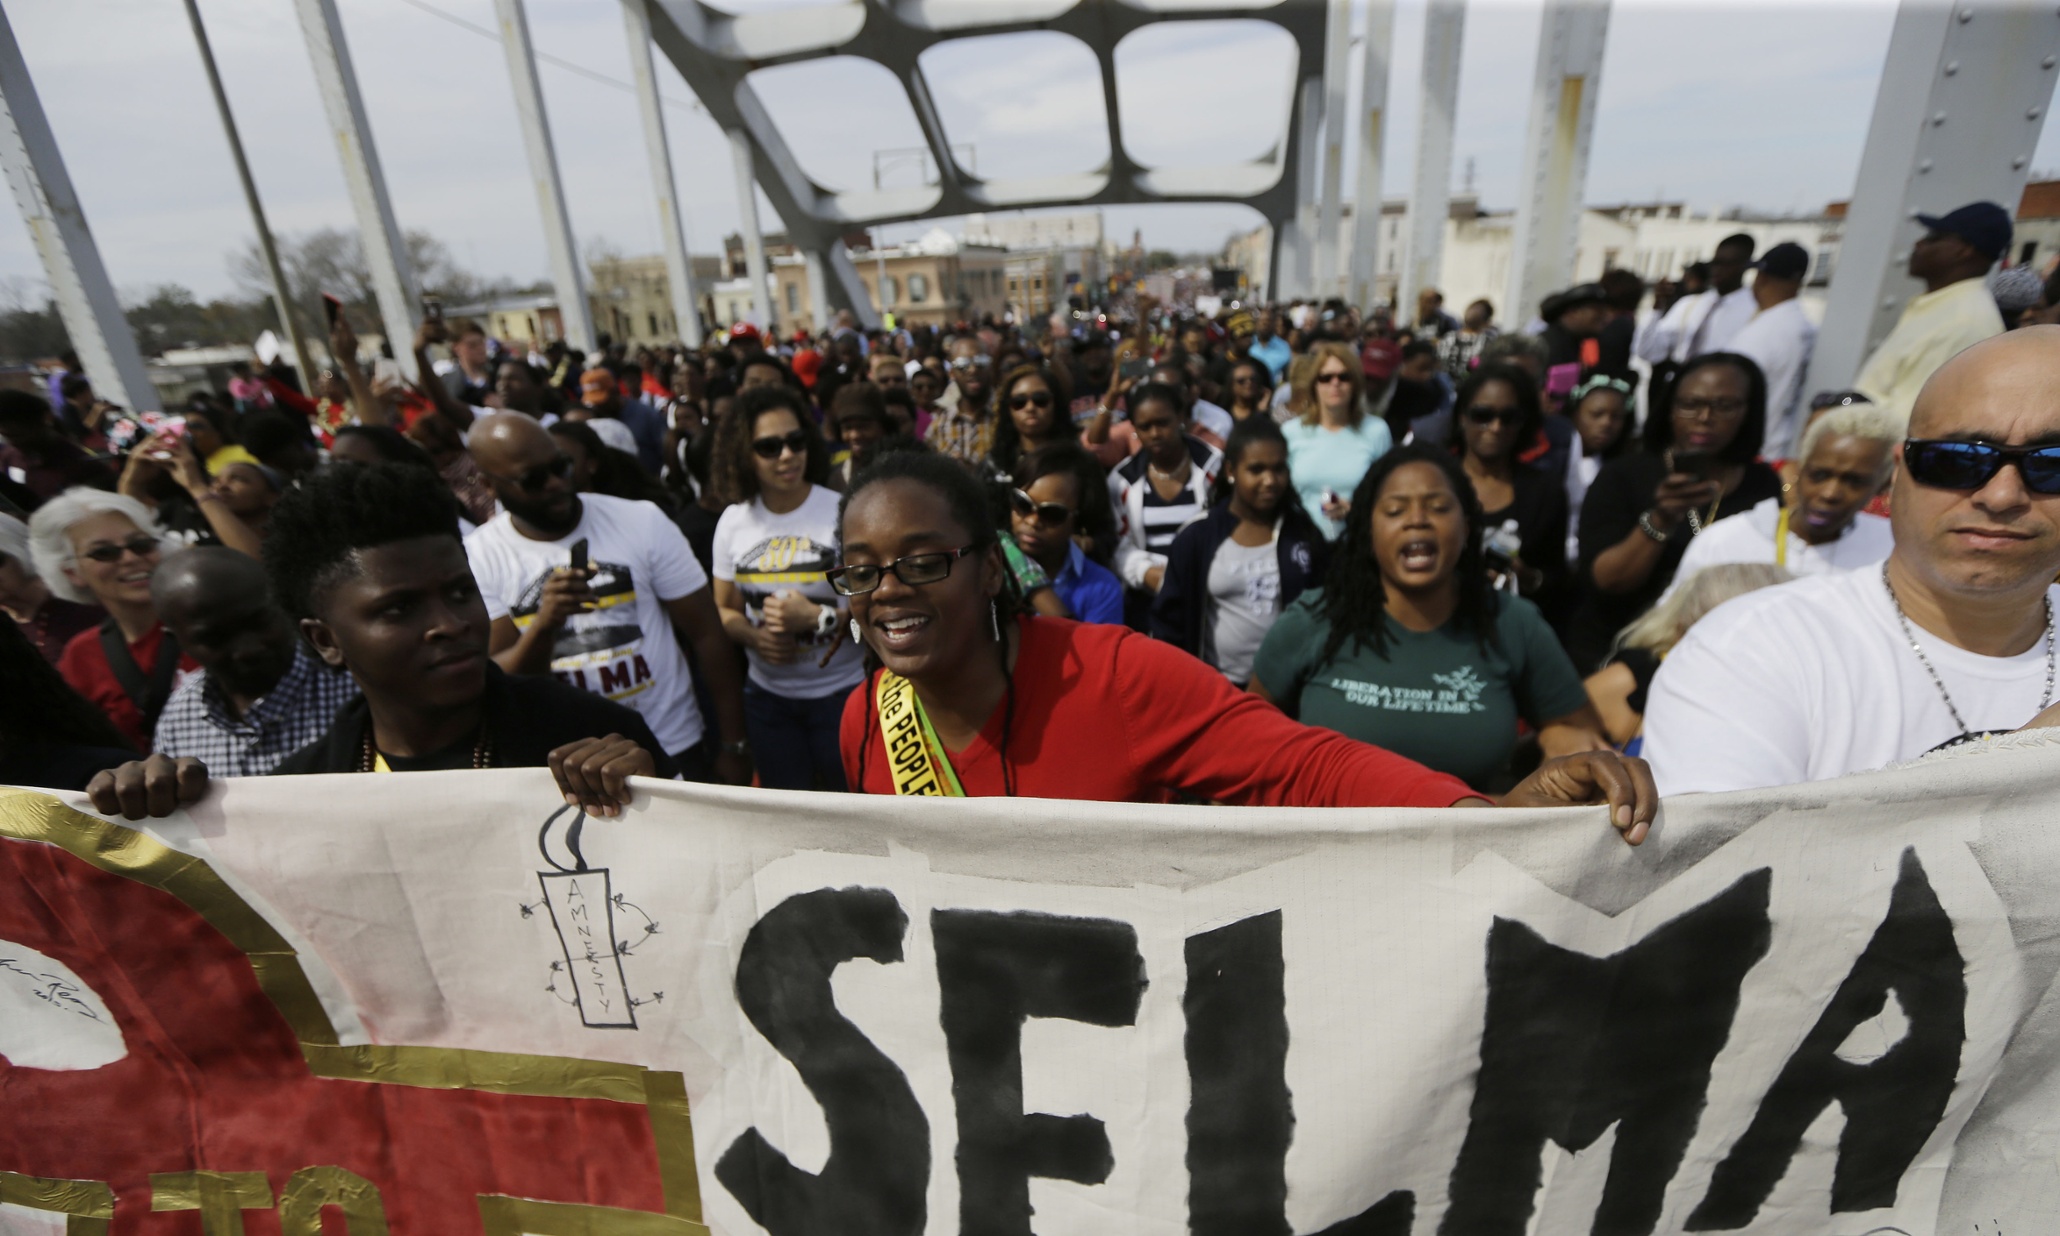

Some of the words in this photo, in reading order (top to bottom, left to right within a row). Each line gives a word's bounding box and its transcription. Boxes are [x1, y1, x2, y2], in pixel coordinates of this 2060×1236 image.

[882, 680, 911, 720] the
[1330, 678, 1433, 700] LIBERATION
[1436, 689, 1459, 701] IN
[1345, 691, 1380, 707] OUR
[1382, 697, 1471, 714] LIFETIME
[888, 712, 937, 796] PEOPLE
[567, 878, 620, 1013] AMNESTY
[715, 844, 1968, 1236] SELMA
